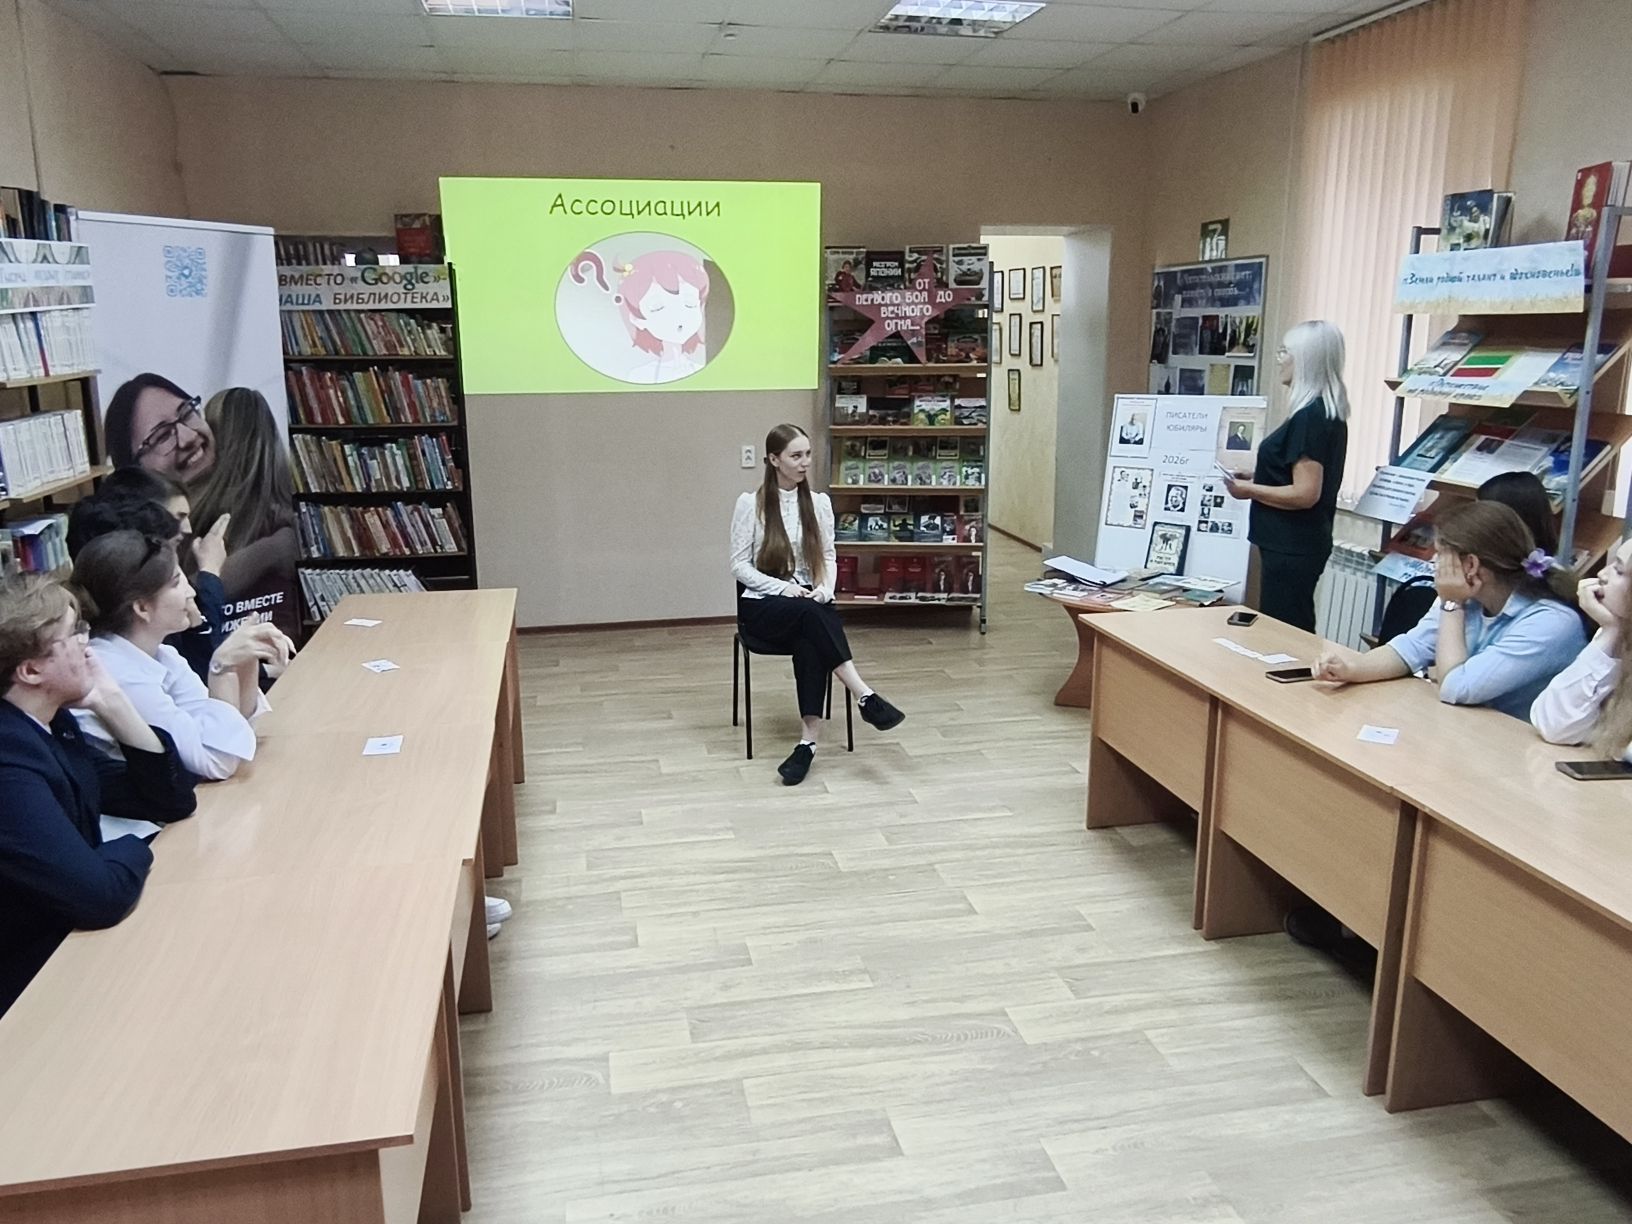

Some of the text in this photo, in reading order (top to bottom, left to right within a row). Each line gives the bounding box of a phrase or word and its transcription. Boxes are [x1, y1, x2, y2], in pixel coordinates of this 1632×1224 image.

[549, 193, 721, 220] Ассоциации
[279, 273, 345, 287] ВМЕСТО
[915, 278, 930, 290] ОТ
[332, 291, 450, 306] БИБЛИОТЕКА»
[855, 290, 953, 305] ПЕРВОГО БОЯ ДО
[880, 304, 932, 318] ВЕЧНОГО
[1166, 411, 1208, 420] ПИСАТЕЛИ
[1166, 424, 1208, 433] ЮБИЛЯРЫ
[235, 592, 284, 612] ВМЕСТЕ
